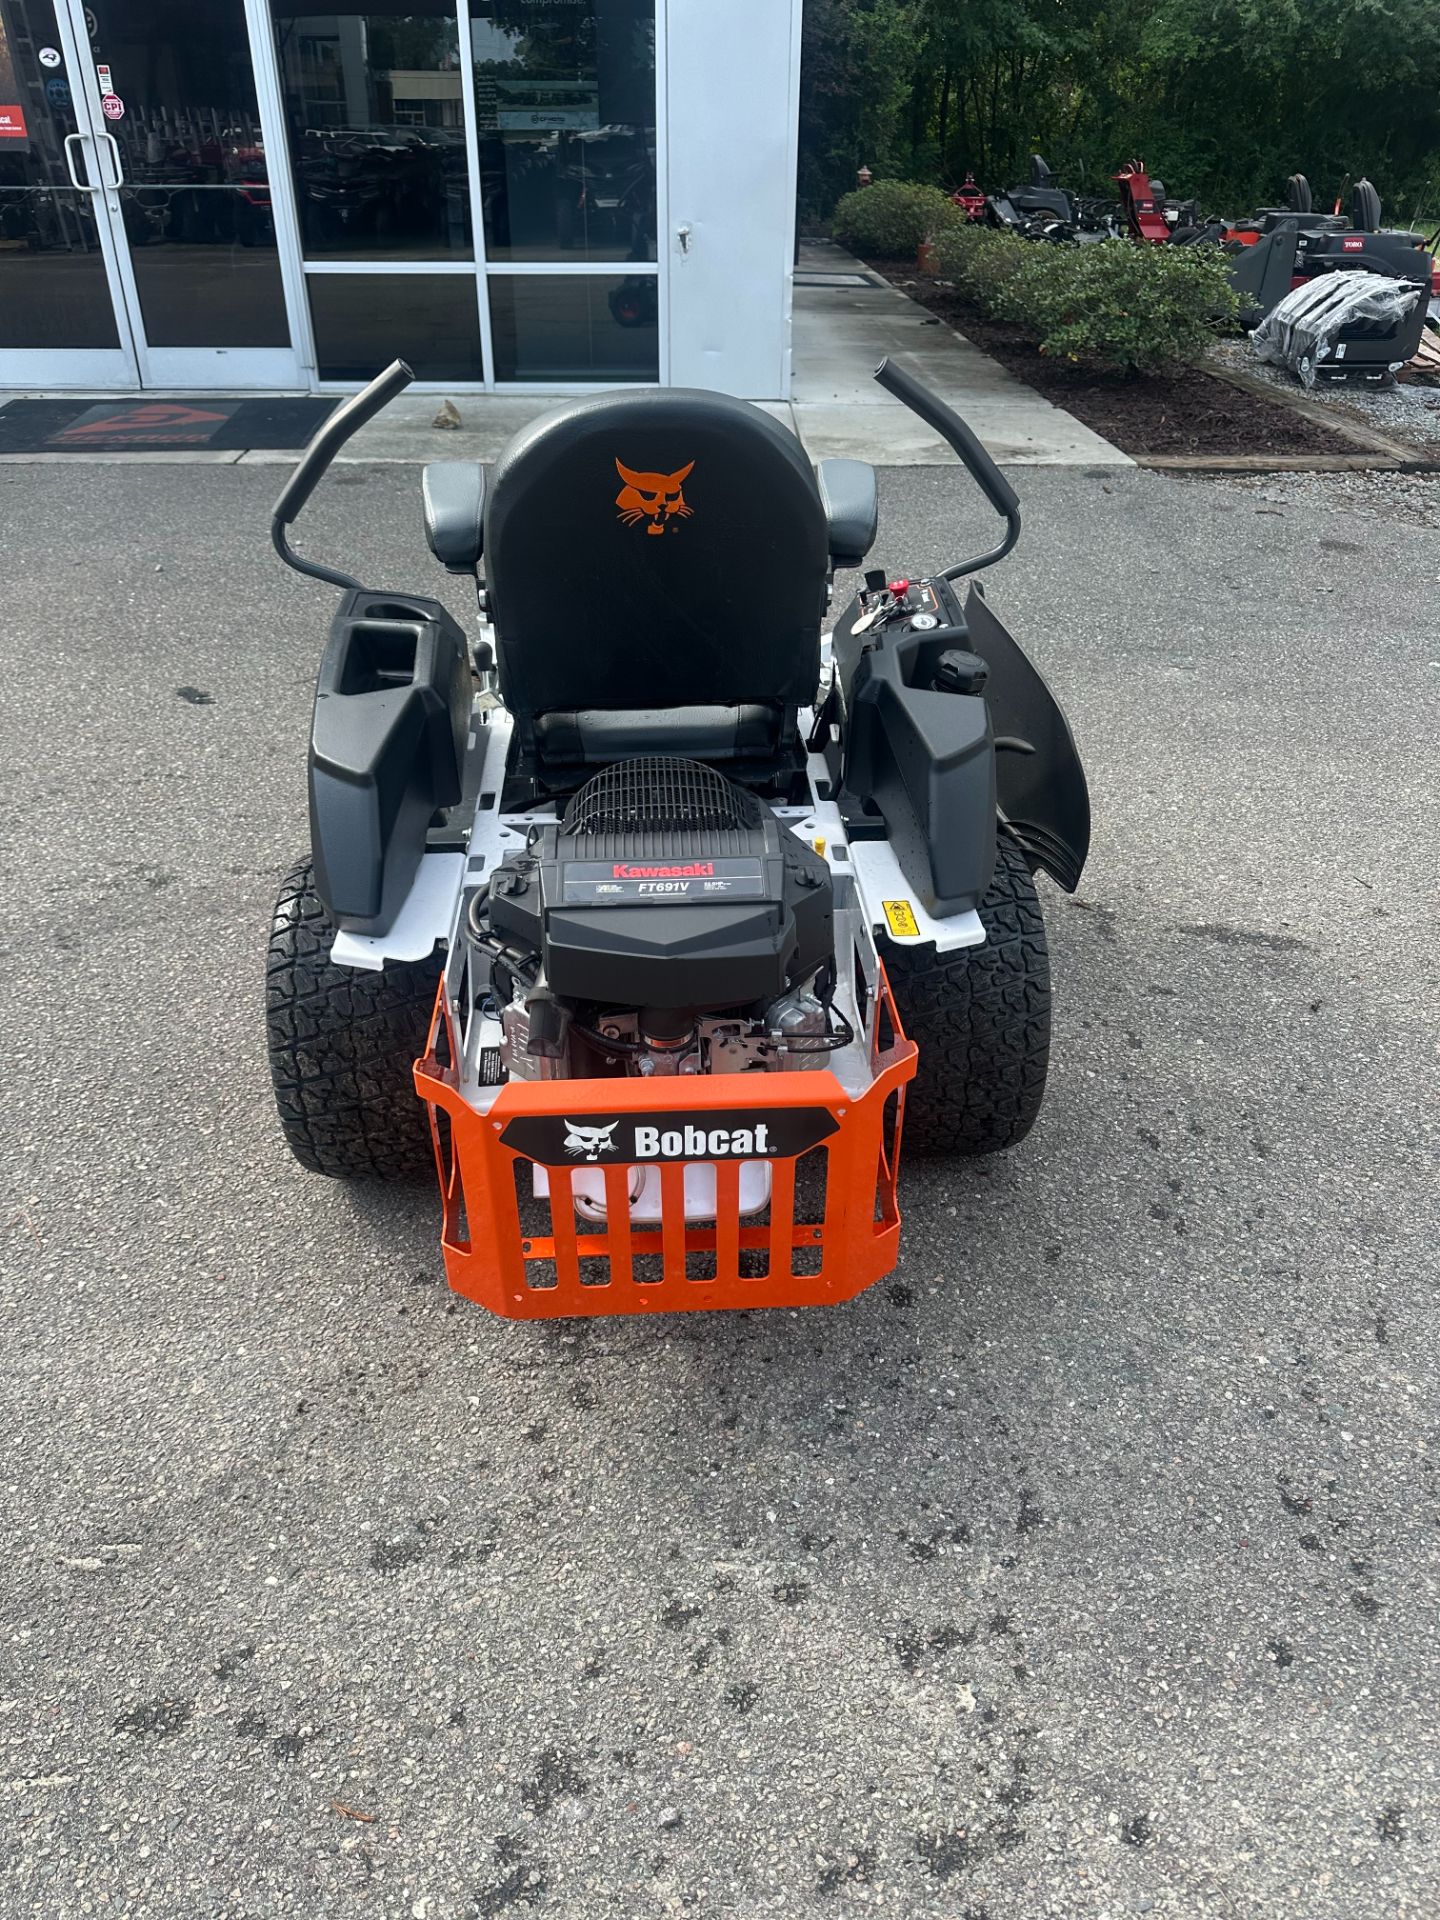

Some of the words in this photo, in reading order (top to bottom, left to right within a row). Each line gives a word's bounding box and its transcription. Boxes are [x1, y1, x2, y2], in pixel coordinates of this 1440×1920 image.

[104, 102, 122, 111] CPI
[612, 863, 714, 878] Kawasaki
[638, 882, 690, 893] FT691V
[634, 1123, 769, 1157] Bobcat
